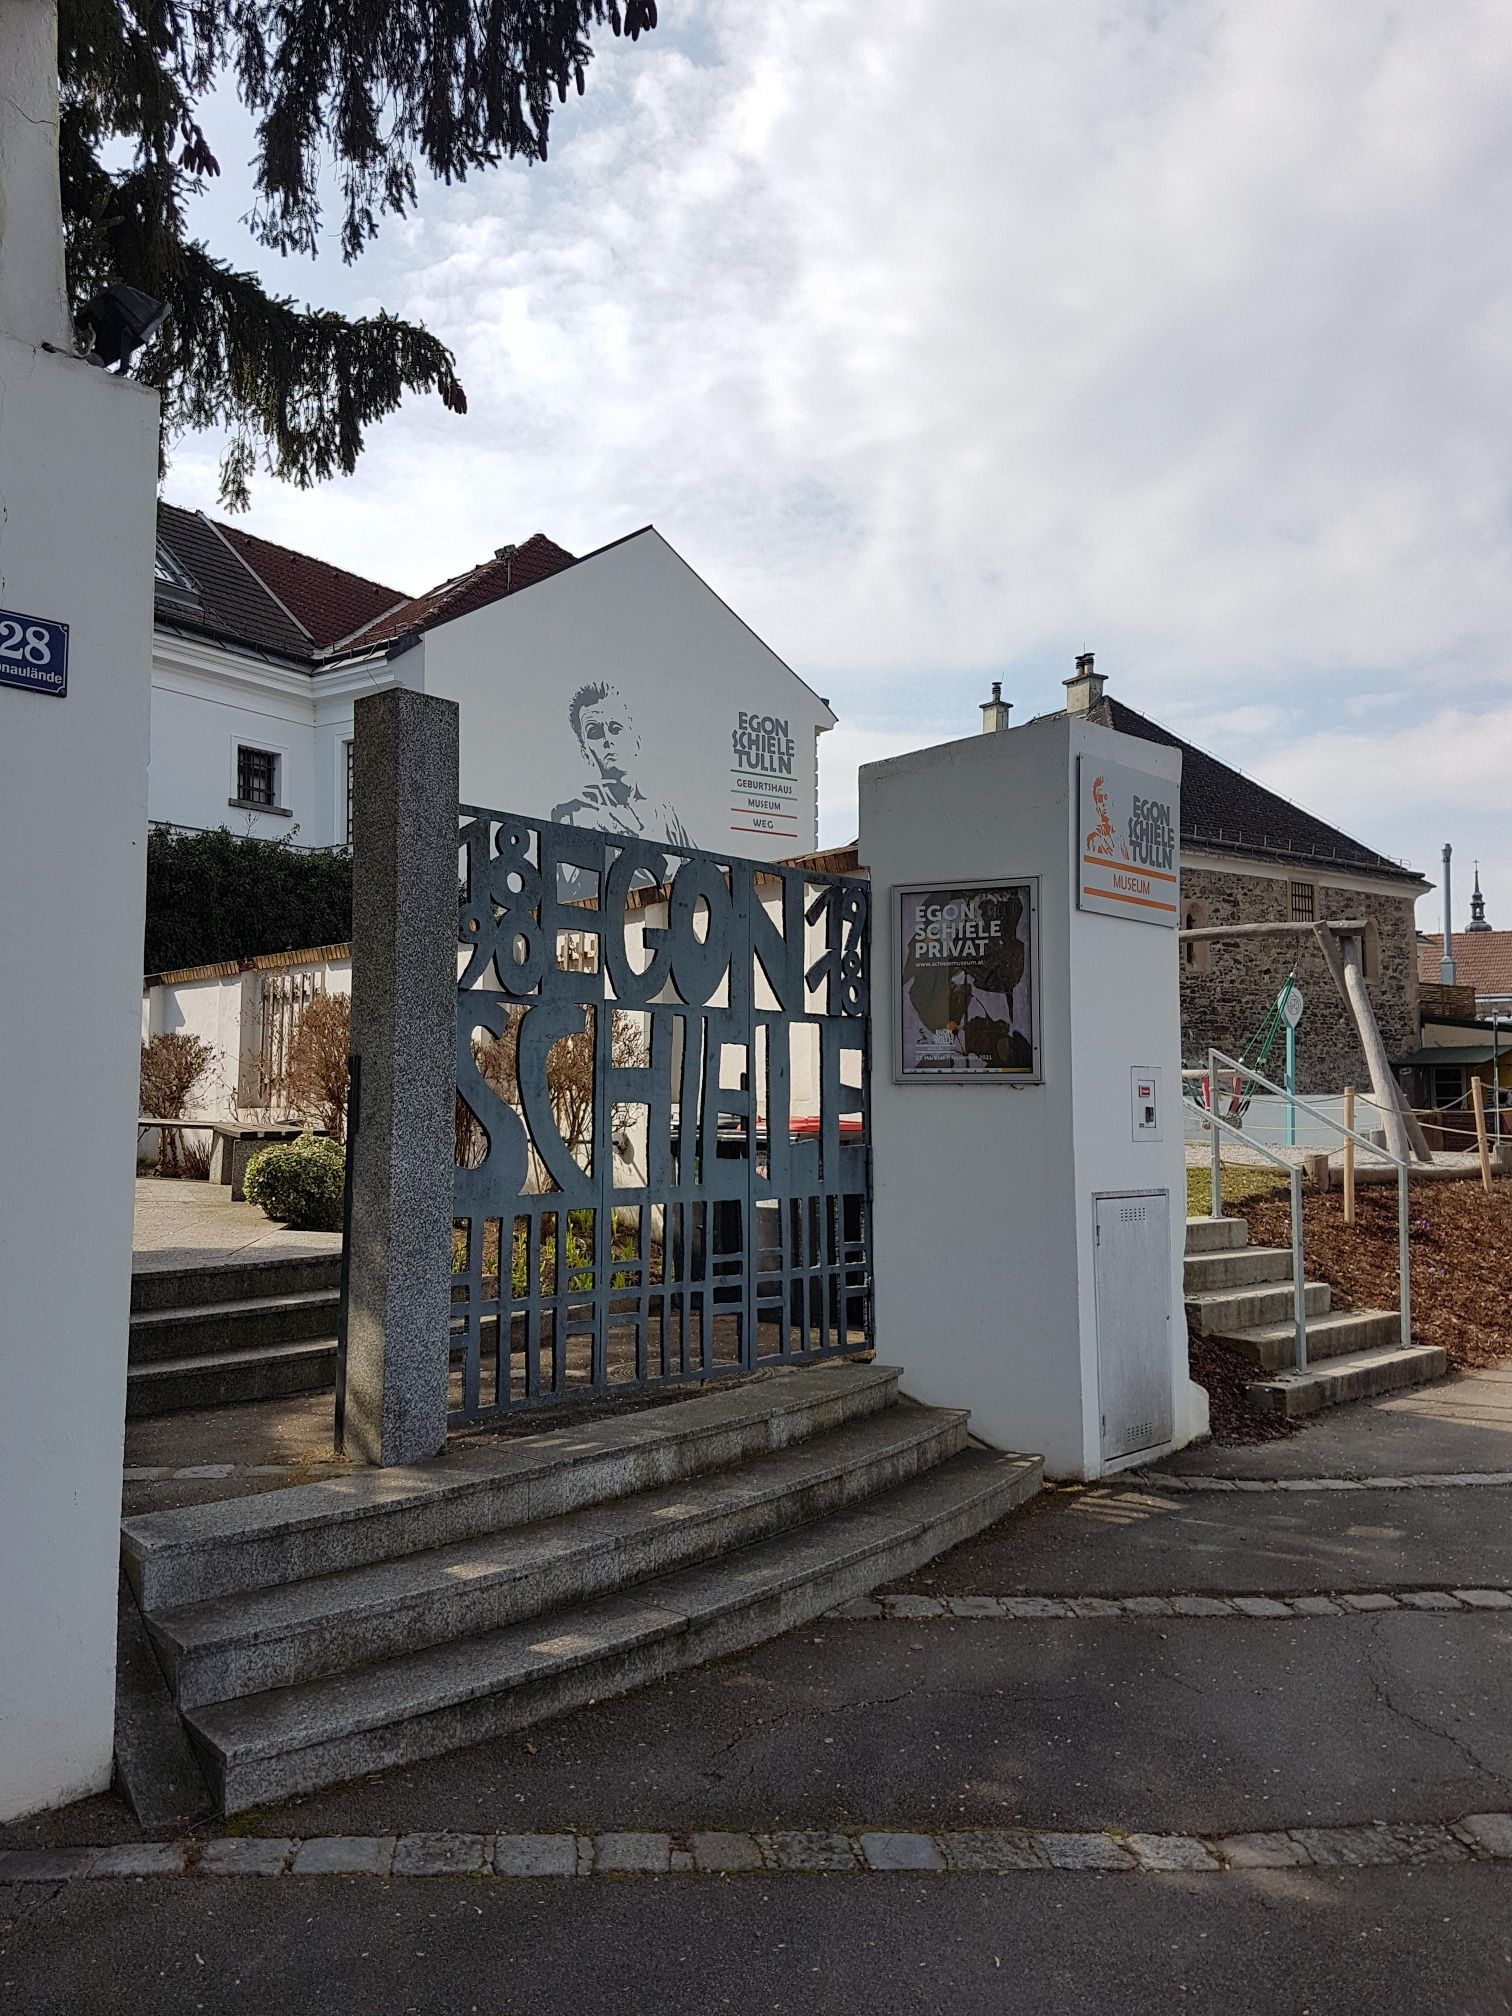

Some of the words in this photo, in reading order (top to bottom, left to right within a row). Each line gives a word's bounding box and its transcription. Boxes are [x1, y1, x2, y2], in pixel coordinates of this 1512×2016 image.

[0, 620, 51, 665] 28
[0, 663, 62, 684] naulände
[738, 711, 789, 738] EGON
[732, 729, 795, 757] SCHIELE
[733, 748, 792, 774] TULLN
[736, 779, 792, 794] GEBURTSHAUS
[748, 798, 781, 811] MUSEUM
[1132, 795, 1170, 826] EGON
[752, 819, 774, 829] WEG
[1127, 816, 1175, 850] SCHIELE
[1129, 838, 1173, 870] TULLN
[1113, 873, 1150, 895] MUSEUM
[541, 832, 803, 1012] EGON
[915, 901, 975, 921] EGON
[914, 920, 1001, 940] SCHIELE
[915, 939, 989, 958] PRIVAT
[915, 960, 984, 968] www.schielemuseum.at
